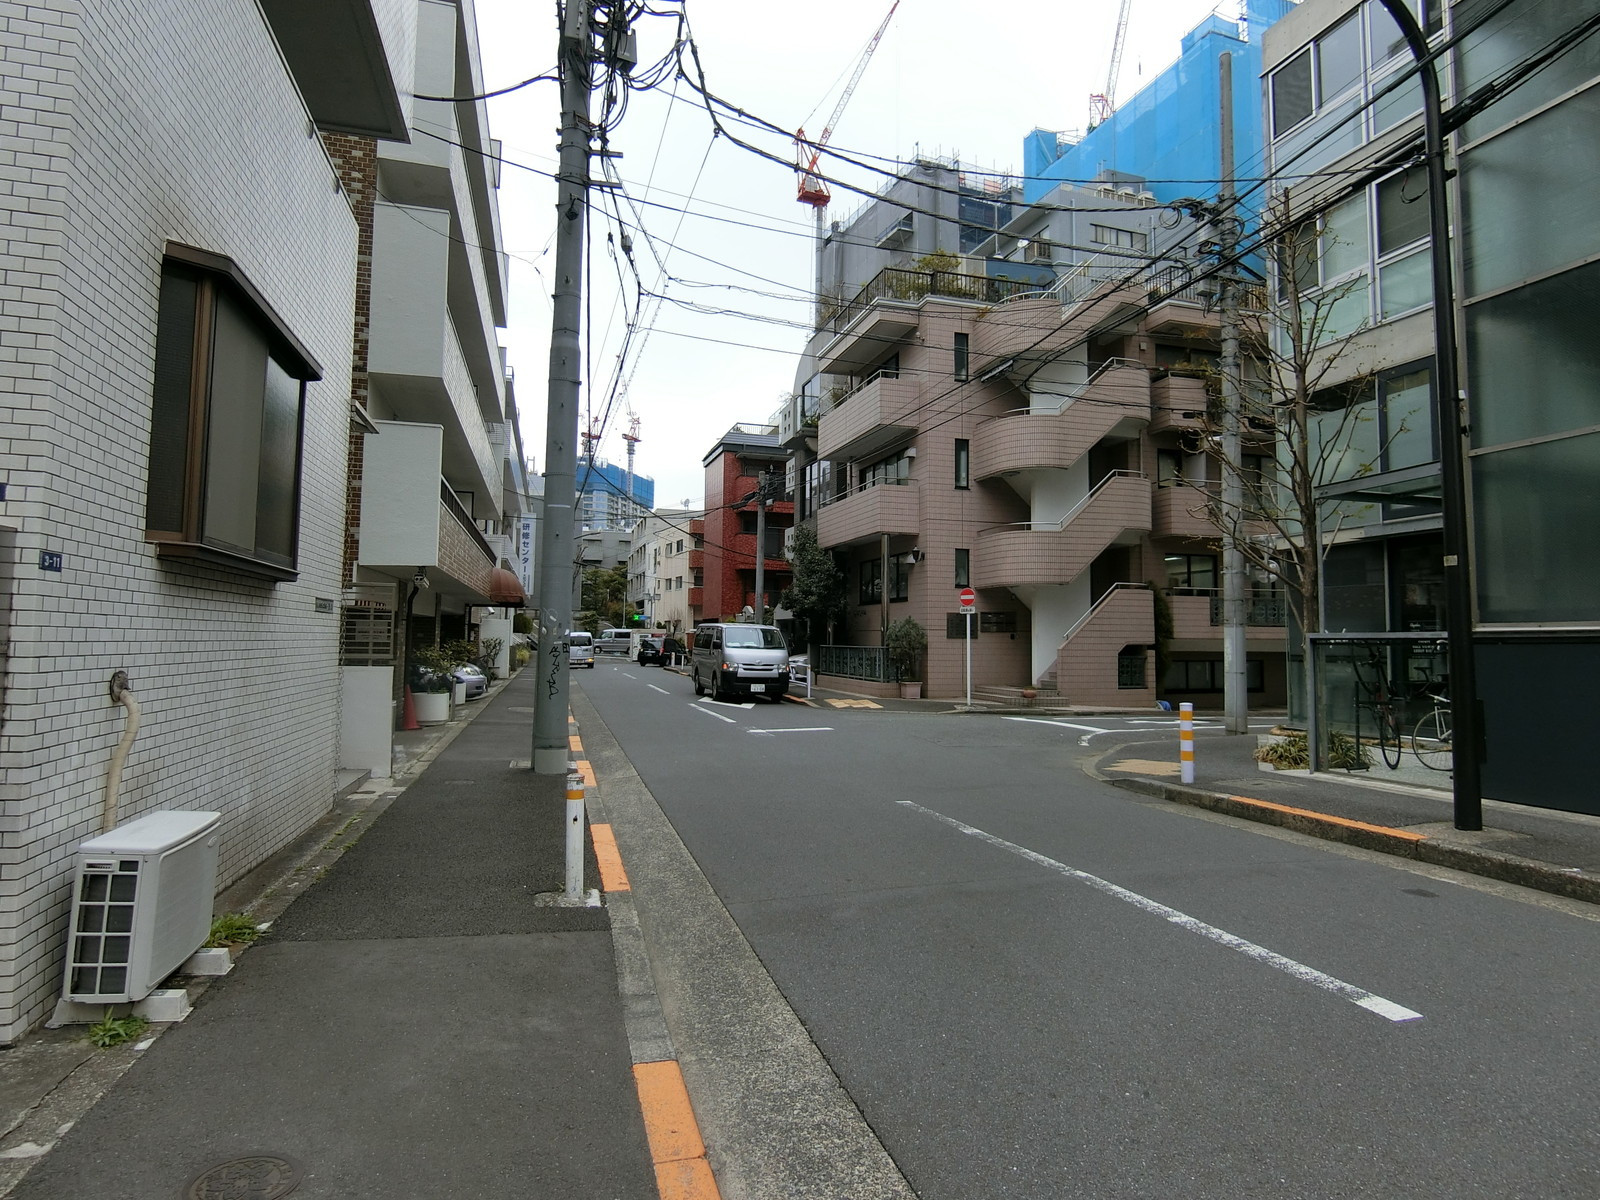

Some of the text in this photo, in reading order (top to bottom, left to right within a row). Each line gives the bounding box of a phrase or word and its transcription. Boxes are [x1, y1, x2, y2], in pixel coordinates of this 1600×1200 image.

[44, 556, 60, 567] 3-11
[522, 523, 530, 573] 研修センター
